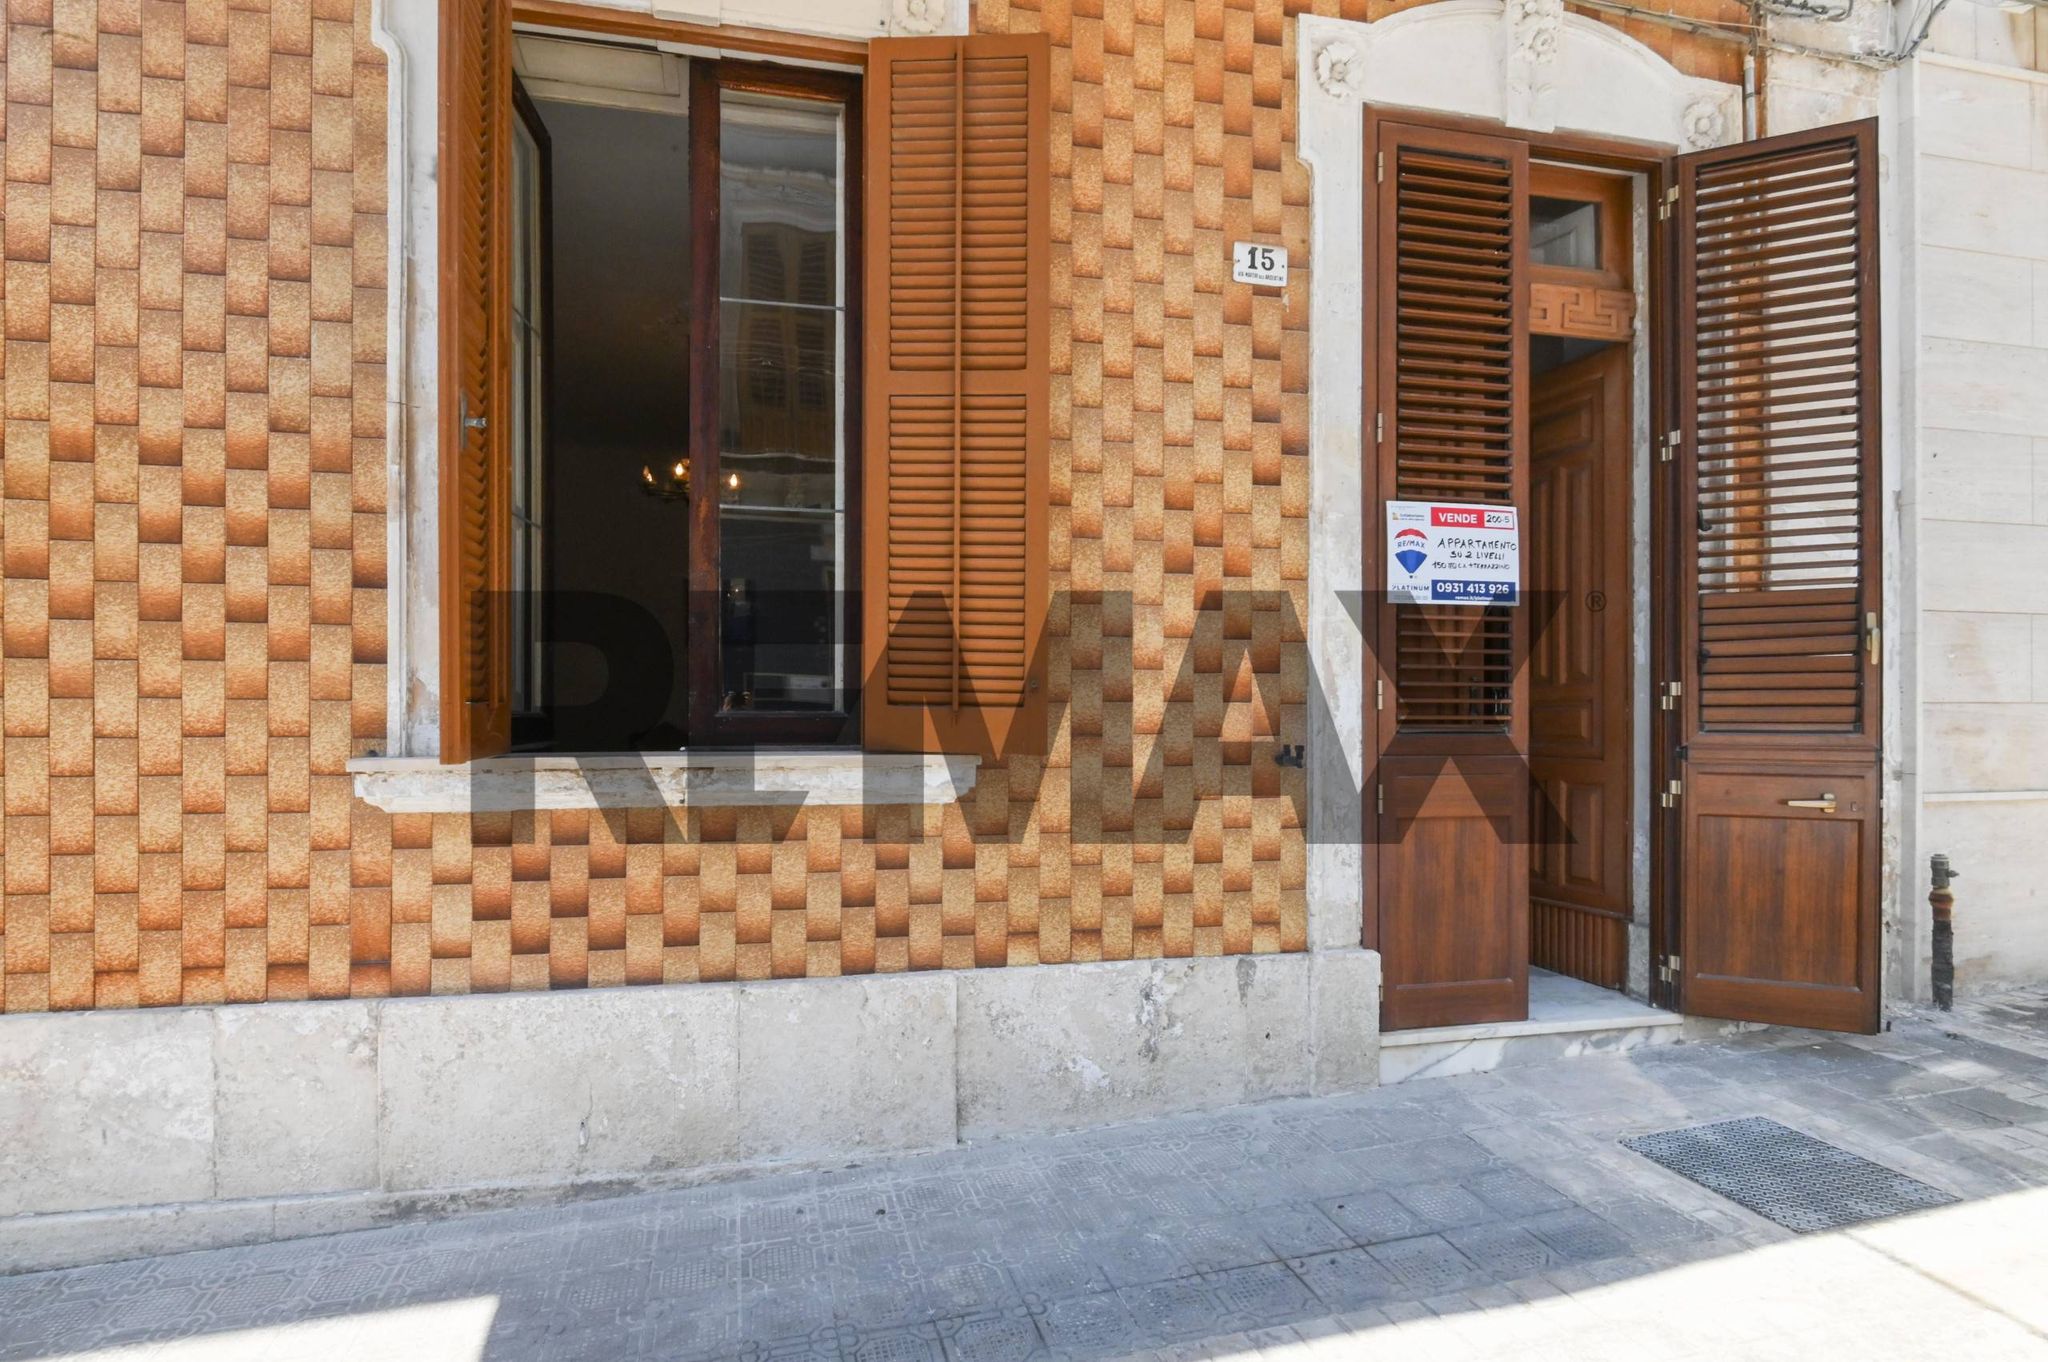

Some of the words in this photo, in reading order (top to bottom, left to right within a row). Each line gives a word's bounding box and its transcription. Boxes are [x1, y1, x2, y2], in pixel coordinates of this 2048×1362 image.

[1248, 246, 1275, 271] 15
[1438, 512, 1478, 524] VENDE
[1397, 540, 1425, 548] RE/MAX
[1437, 537, 1517, 551] APPARTAMENTO
[1450, 550, 1462, 558] SU
[1476, 552, 1505, 561] LIVELLI
[1432, 561, 1447, 569] 150
[1437, 582, 1464, 593] 0931
[1467, 583, 1486, 594] 413
[1489, 584, 1509, 594] 926
